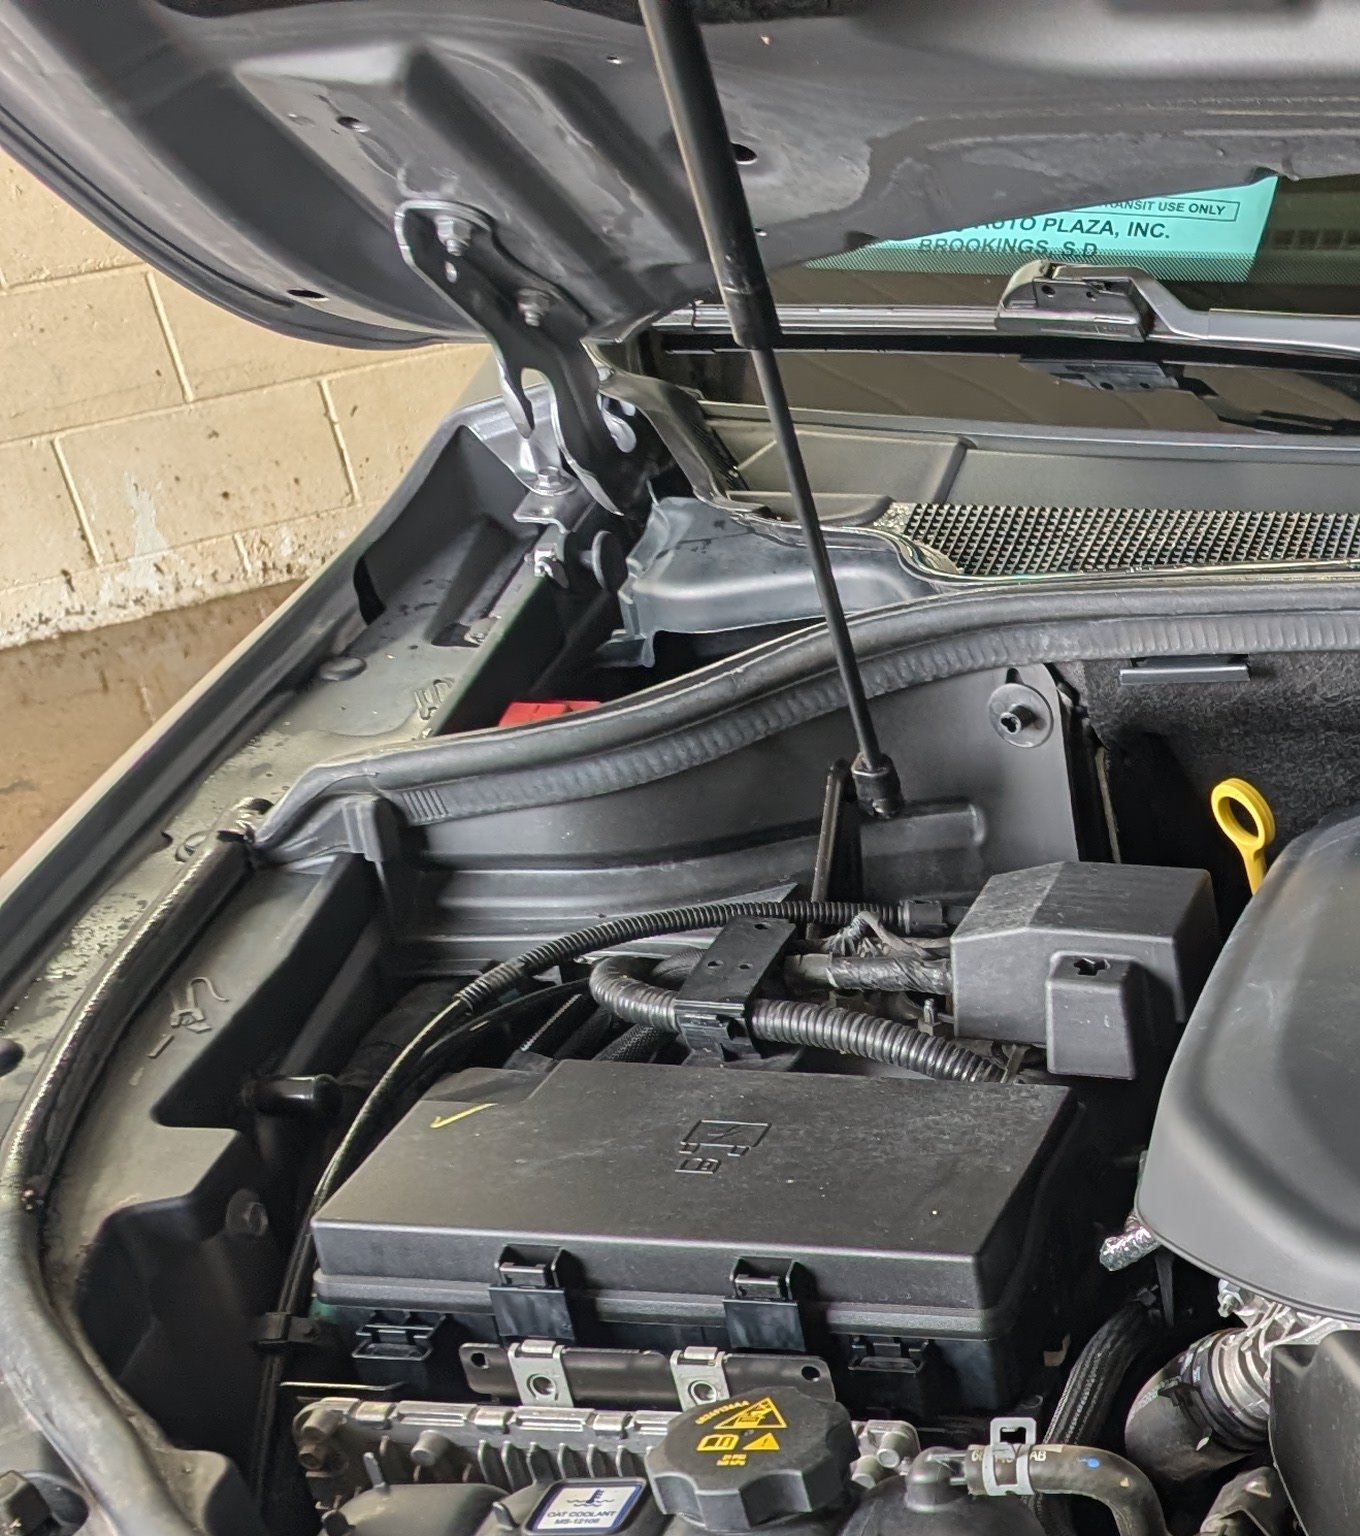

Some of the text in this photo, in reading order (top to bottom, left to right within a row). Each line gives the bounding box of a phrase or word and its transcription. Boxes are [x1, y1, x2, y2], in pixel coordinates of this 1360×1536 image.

[1158, 202, 1185, 212] USE
[1188, 203, 1226, 215] ONLY
[1042, 218, 1119, 238] PLAZA,
[1127, 221, 1170, 239] INC.
